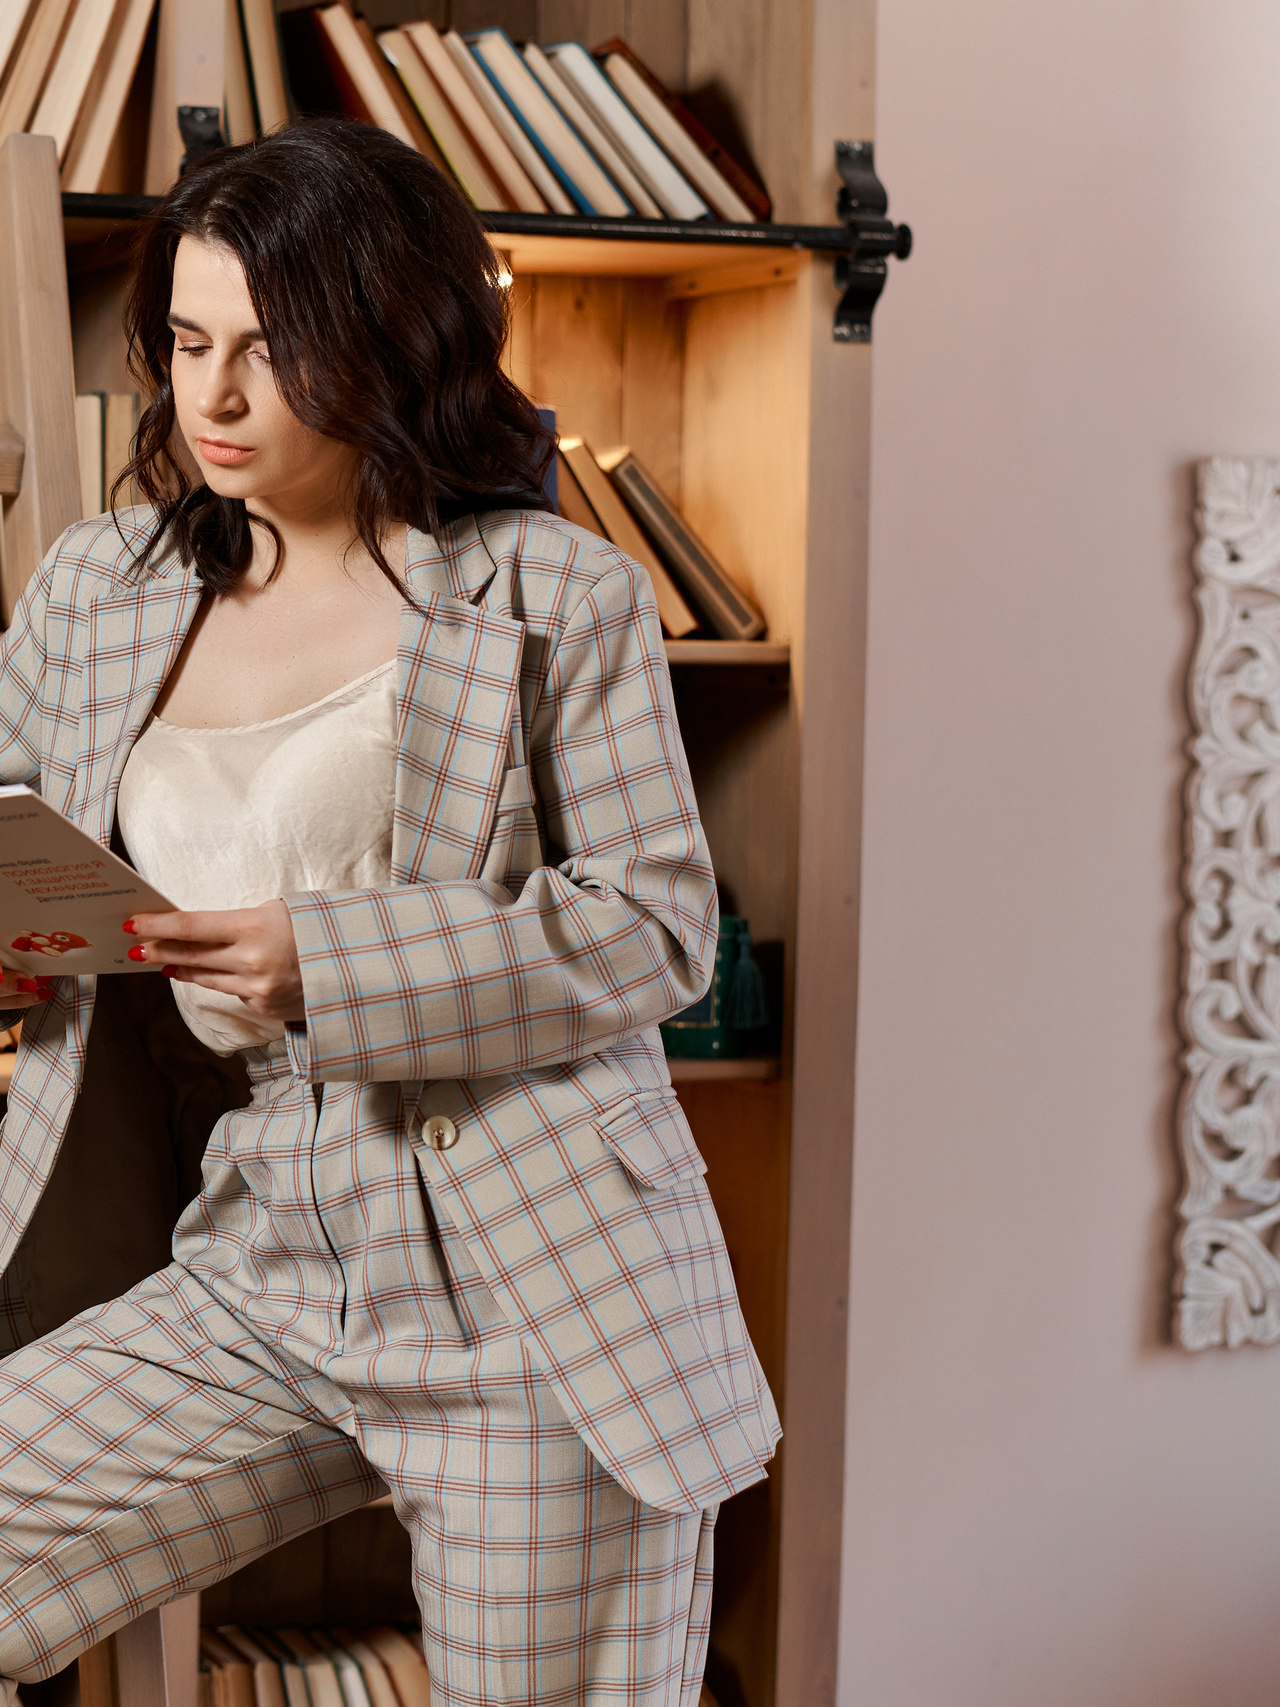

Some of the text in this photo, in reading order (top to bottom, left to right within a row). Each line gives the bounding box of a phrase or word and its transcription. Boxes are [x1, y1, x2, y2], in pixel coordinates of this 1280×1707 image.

[2, 859, 107, 878] ПСИХОЛОГИЯ Я
[13, 872, 102, 888] И ЗАЩИТНЫЕ
[24, 880, 110, 895] МЕХАНИЗМЫ
